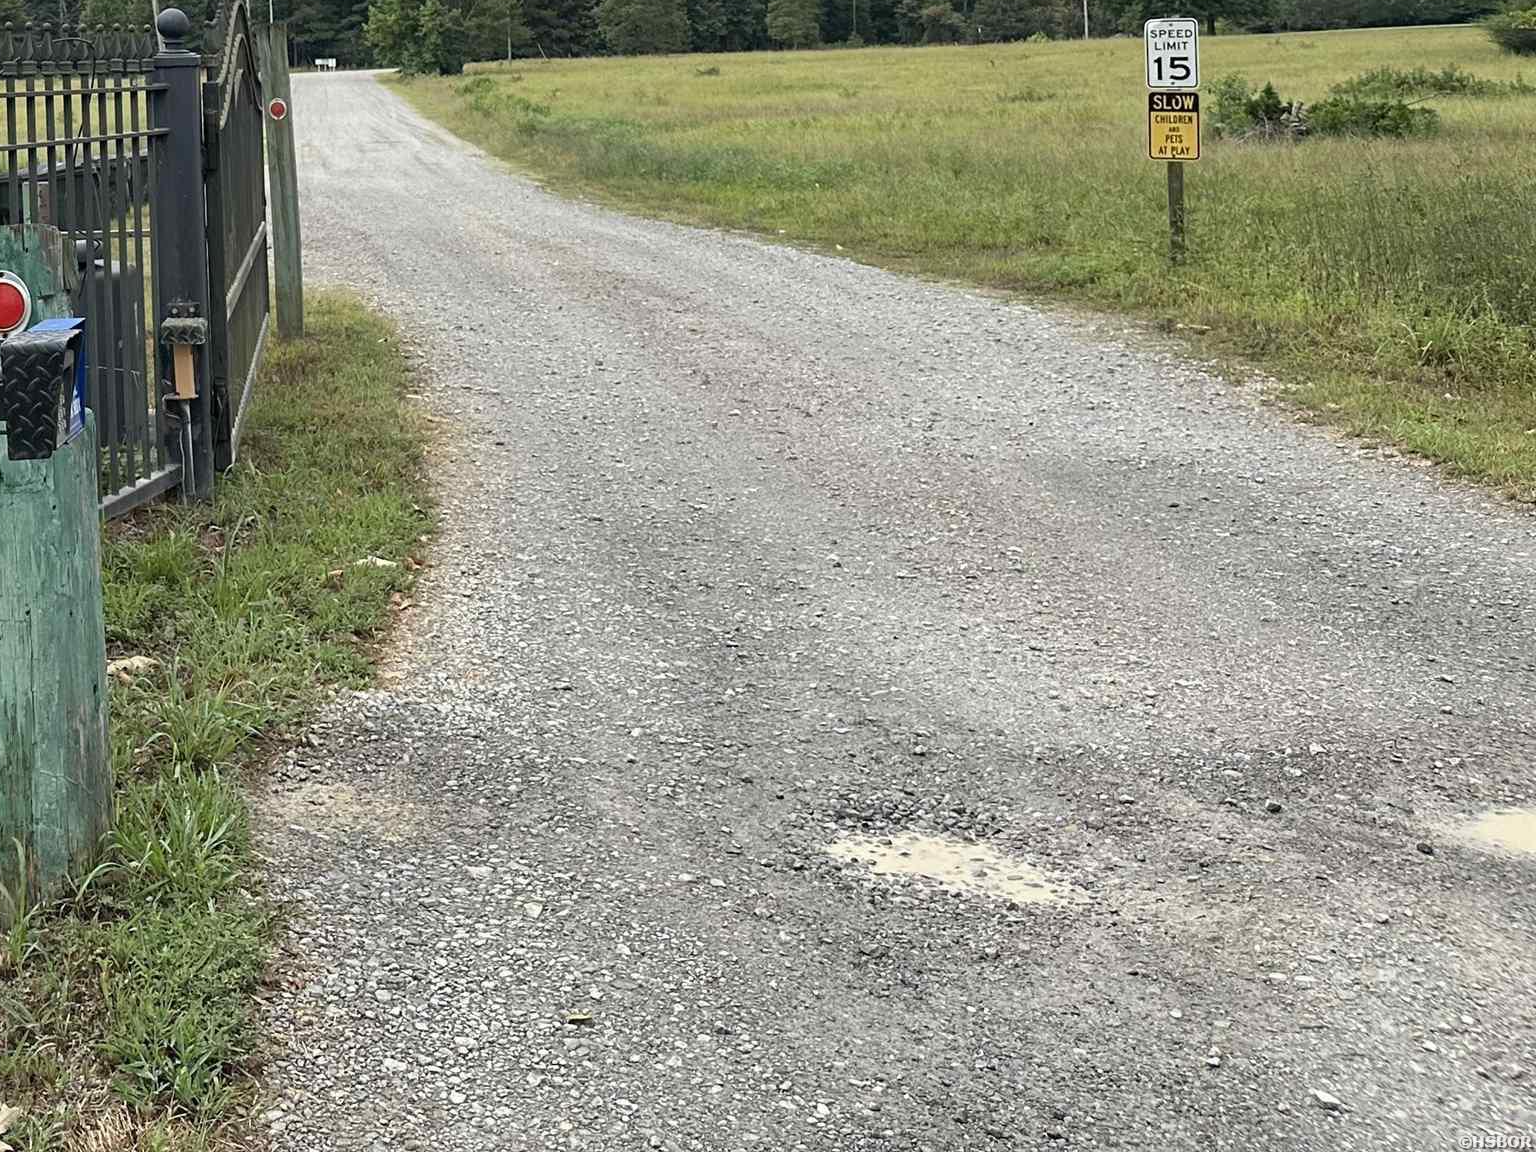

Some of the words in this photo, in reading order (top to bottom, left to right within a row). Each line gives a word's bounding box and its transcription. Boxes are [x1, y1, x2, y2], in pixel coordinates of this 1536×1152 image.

[1150, 29, 1193, 39] SPEED
[1154, 42, 1189, 51] LIMIT
[1154, 56, 1191, 81] 15
[1153, 95, 1194, 110] SLOW
[1154, 115, 1193, 124] CHILDREN
[1165, 134, 1183, 144] PETS
[1158, 147, 1168, 155] AT
[1171, 147, 1190, 156] PLAY
